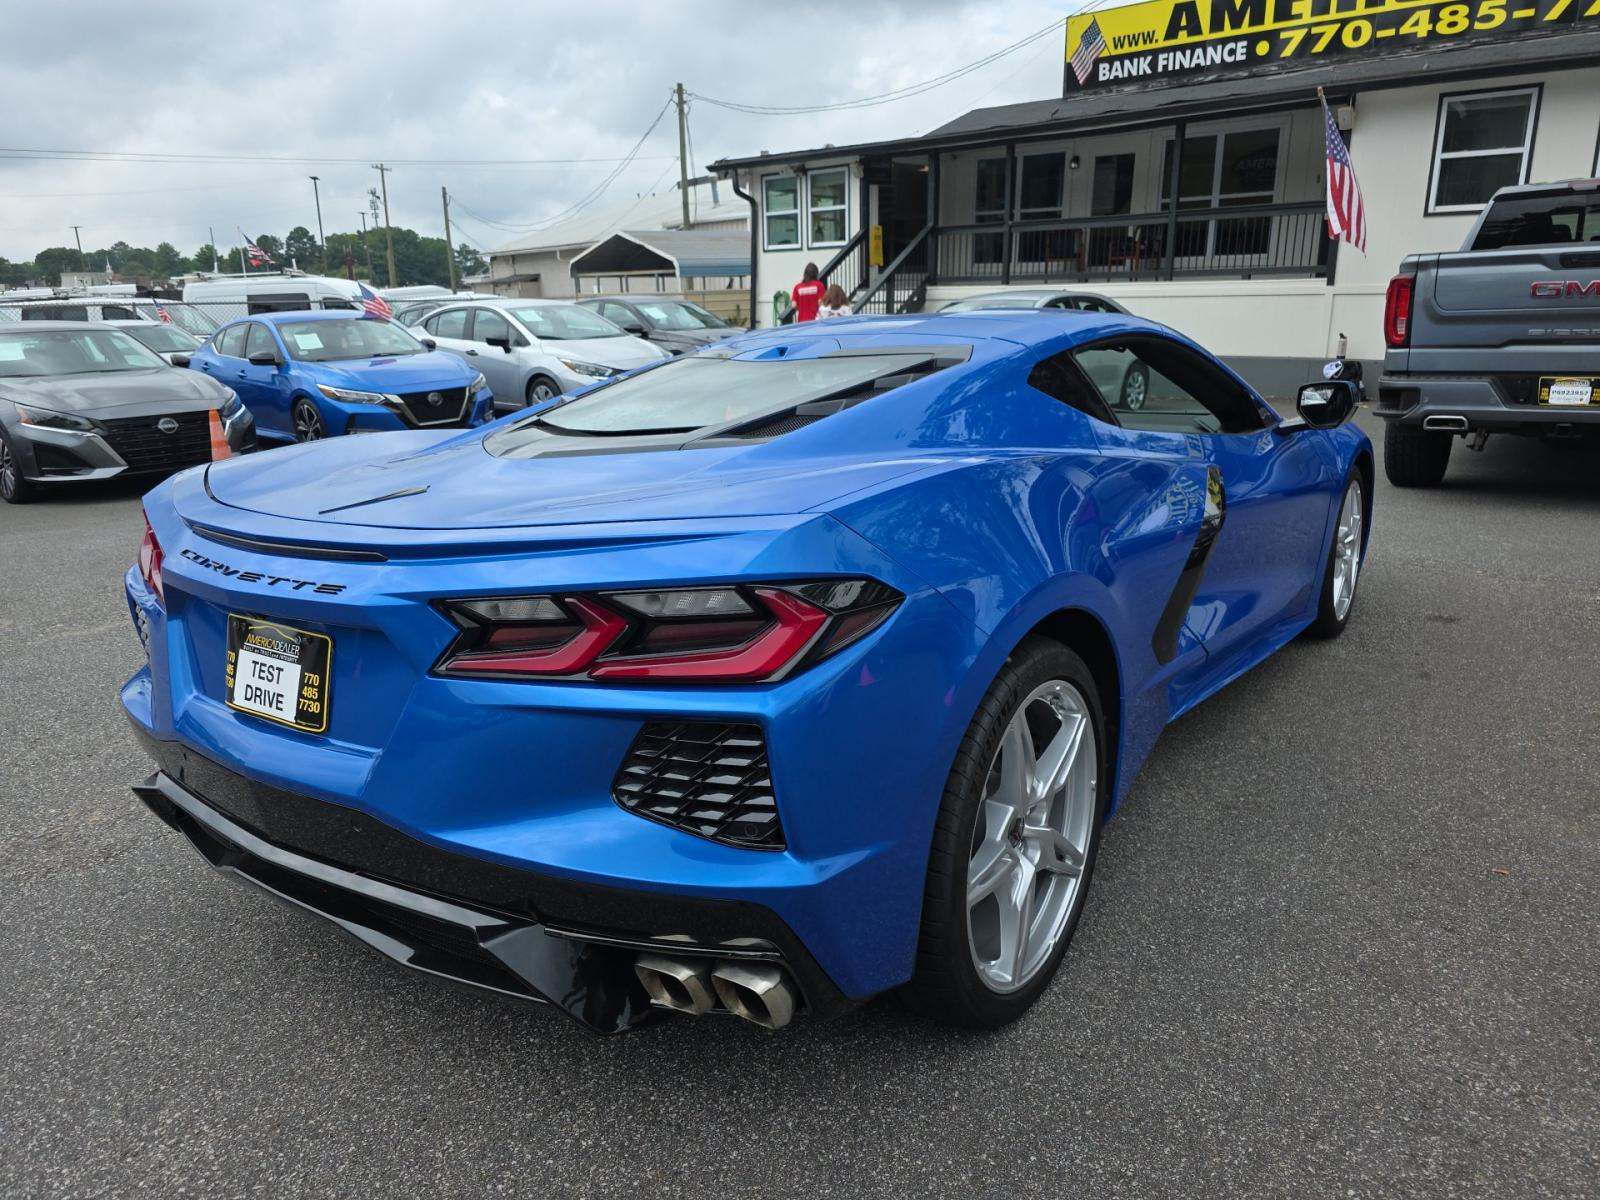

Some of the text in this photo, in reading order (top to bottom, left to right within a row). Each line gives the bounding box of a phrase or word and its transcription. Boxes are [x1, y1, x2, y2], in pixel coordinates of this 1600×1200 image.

[1098, 55, 1152, 82] BANK
[1157, 40, 1248, 73] FINANCE
[180, 549, 347, 595] CORVETTE
[251, 660, 284, 685] TEST
[304, 672, 320, 686] 770
[244, 684, 284, 712] DRIVE
[302, 686, 318, 699] 485
[299, 698, 320, 714] 7730
